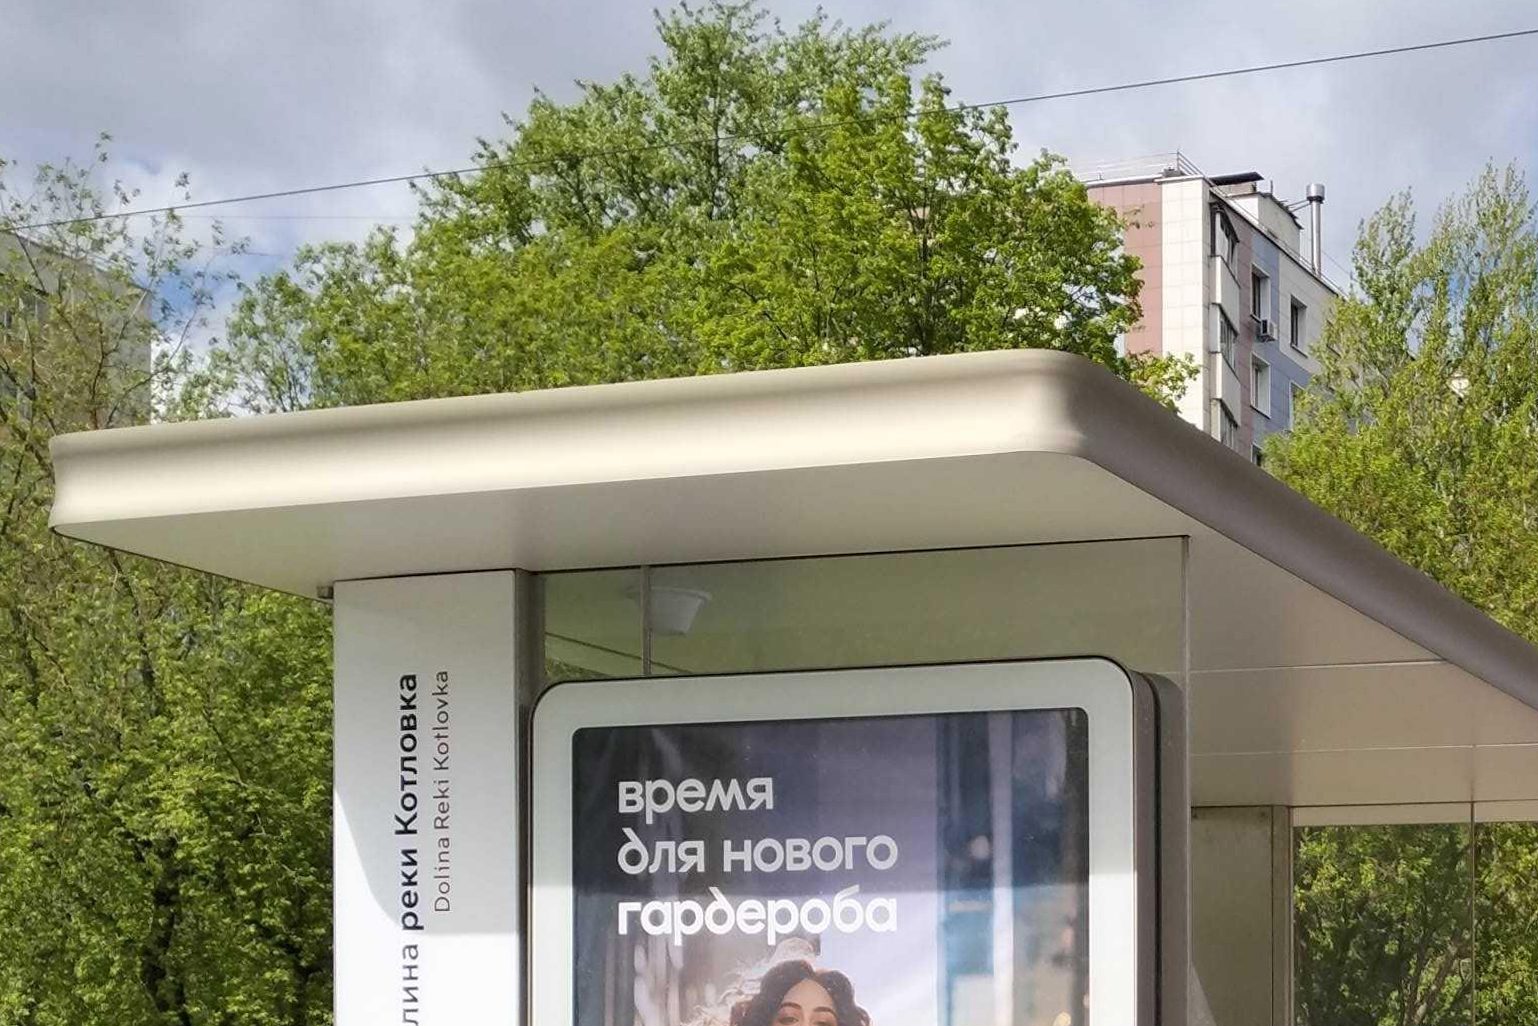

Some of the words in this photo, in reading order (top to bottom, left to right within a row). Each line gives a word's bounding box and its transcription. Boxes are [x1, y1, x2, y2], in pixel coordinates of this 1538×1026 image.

[394, 673, 418, 835] Котловка
[432, 671, 450, 771] Kotlovka
[433, 781, 450, 830] Reki
[618, 777, 774, 824] время
[434, 838, 451, 912] Dolina
[617, 827, 705, 875] для
[723, 835, 898, 872] нового
[400, 848, 424, 931] реки
[618, 884, 898, 946] гардероба
